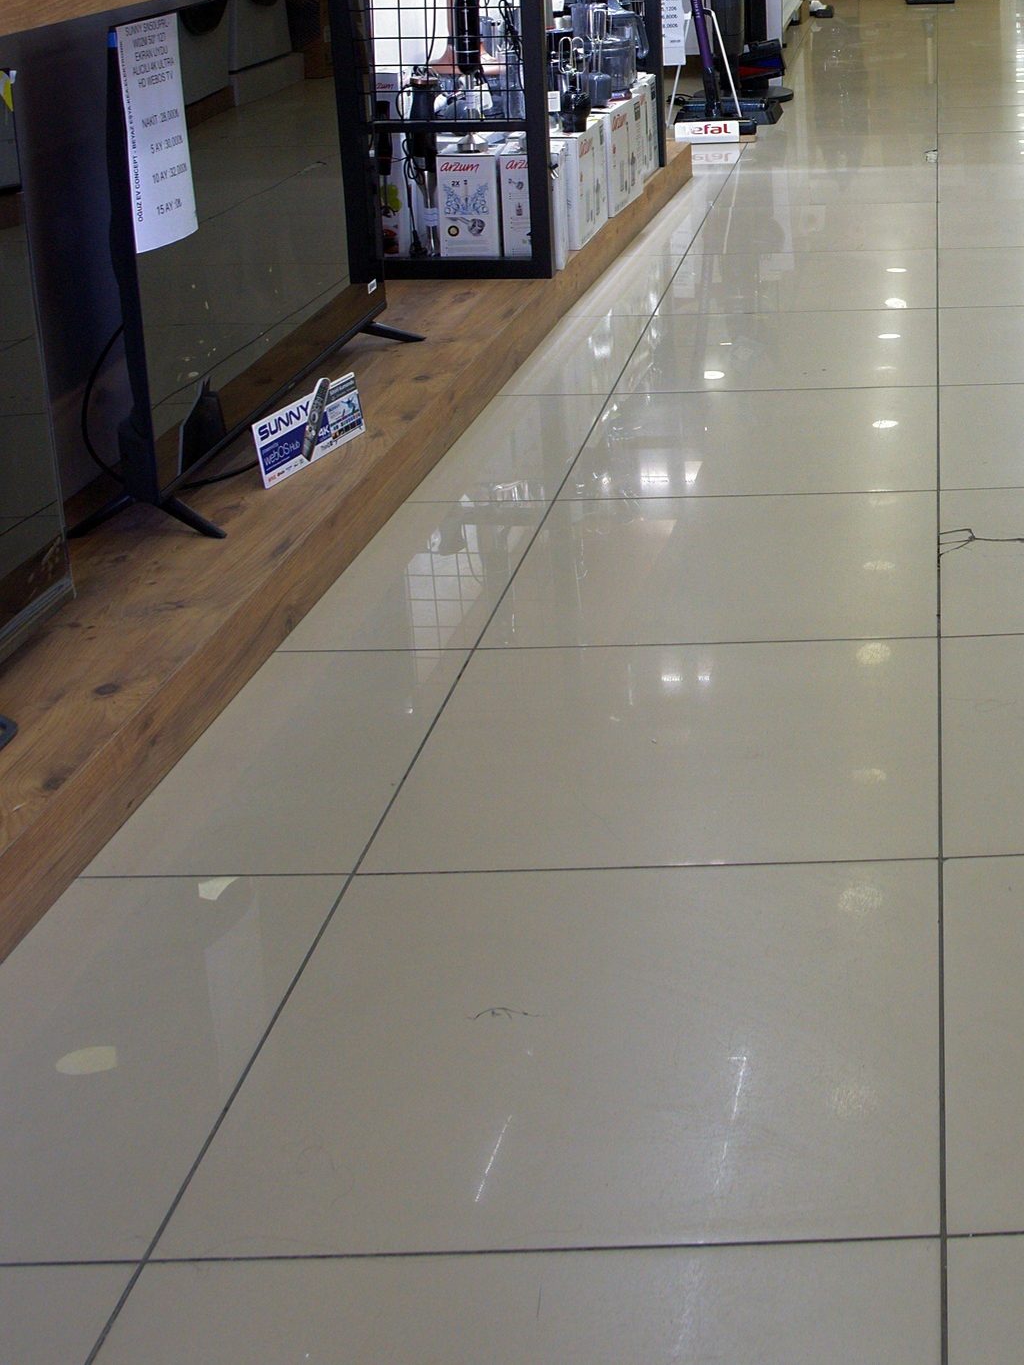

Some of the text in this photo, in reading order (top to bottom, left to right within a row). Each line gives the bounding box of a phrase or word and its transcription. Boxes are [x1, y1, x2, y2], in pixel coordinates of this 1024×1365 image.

[689, 123, 732, 135] efal
[440, 161, 480, 173] arzum
[257, 400, 311, 442] SUNNY
[263, 442, 290, 467] webOS
